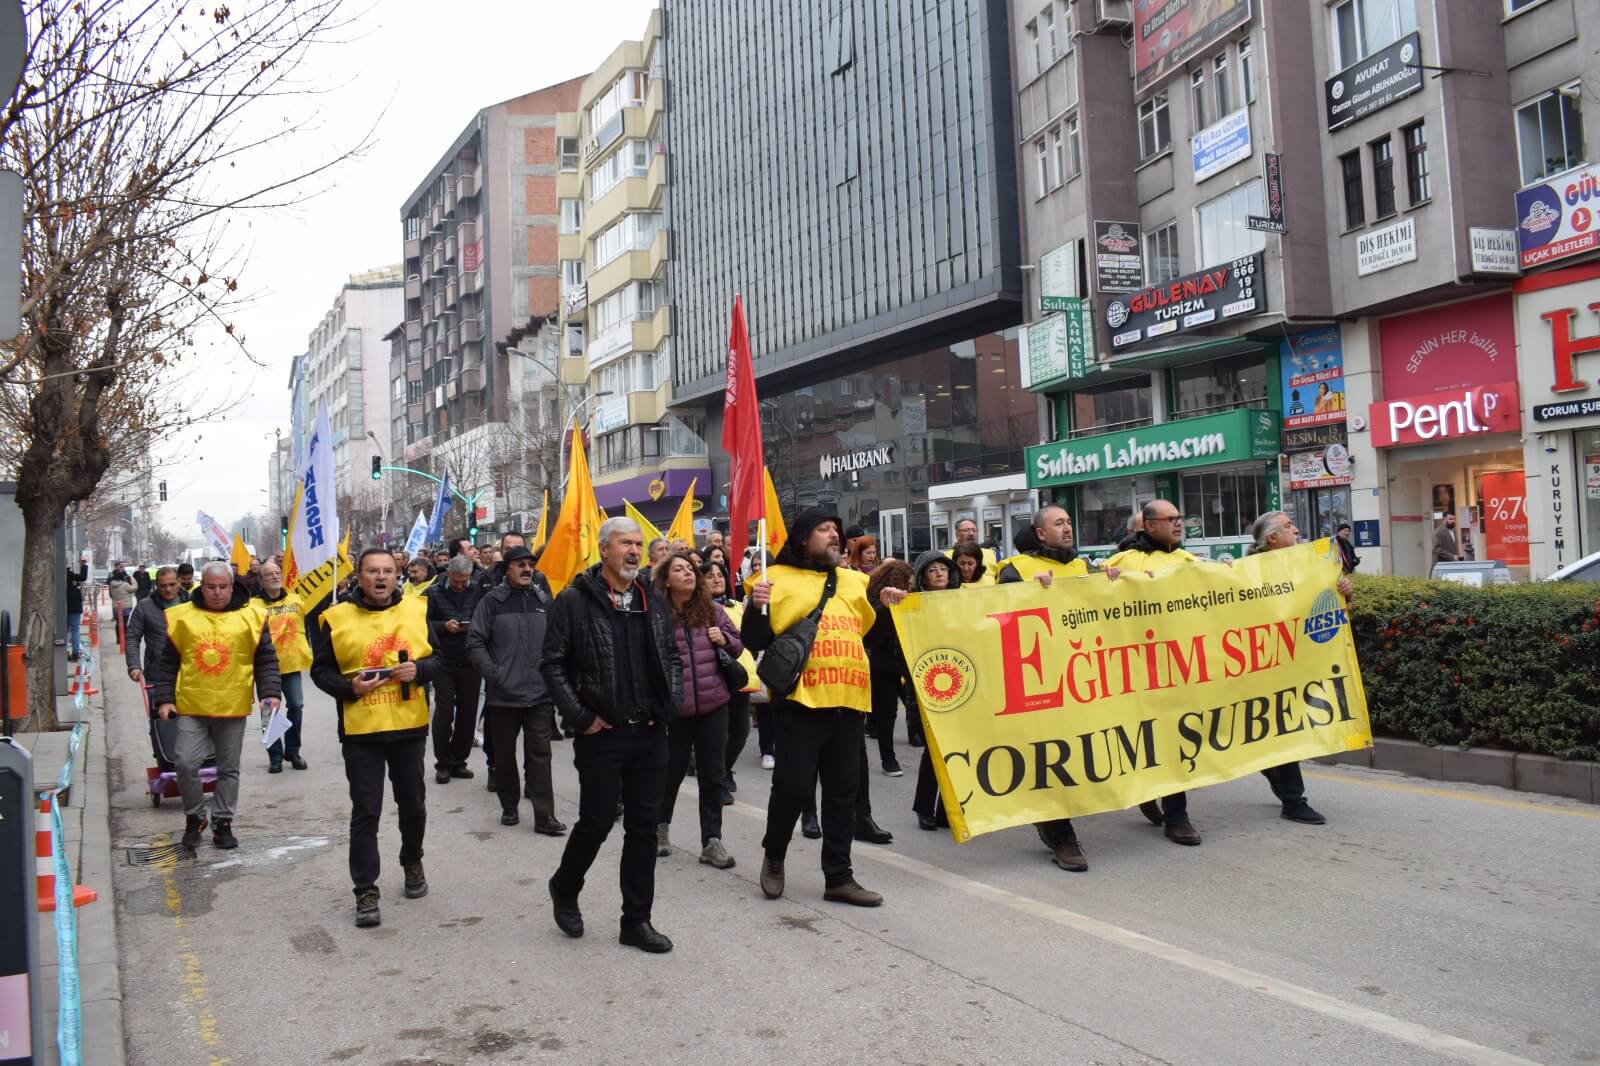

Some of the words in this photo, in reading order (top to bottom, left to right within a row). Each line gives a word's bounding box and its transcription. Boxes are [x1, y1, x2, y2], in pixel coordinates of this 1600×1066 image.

[1354, 57, 1389, 86] AVUKAT
[1332, 99, 1351, 115] Gamze
[1360, 236, 1375, 255] DİŞ
[1376, 221, 1412, 250] HEKİMİ
[1524, 248, 1550, 264] UÇAK
[1551, 234, 1593, 255] BİLETLERİ
[1232, 255, 1254, 269] 0364
[1233, 263, 1255, 279] 666
[1130, 267, 1230, 313] GÜLENAY
[1238, 277, 1252, 289] 19
[1238, 288, 1253, 300] 49
[1042, 298, 1081, 311] Sultan
[1154, 298, 1205, 321] TURİZM
[1069, 311, 1083, 378] LAHMACUN
[1406, 336, 1440, 374] SENİN
[1440, 329, 1467, 346] HER
[1541, 403, 1580, 420] ÇORUM
[832, 446, 891, 474] HALKBANK
[1035, 448, 1101, 480] Sultan
[1103, 432, 1226, 471] Lahmacun
[1061, 608, 1098, 629] eğitim
[1103, 606, 1120, 621] ve
[1123, 600, 1162, 618] bilim
[1166, 587, 1234, 613] emekçileri
[1239, 580, 1295, 602] sendikası
[818, 614, 862, 635] ŞASIN
[1303, 609, 1349, 635] KESK
[986, 607, 1212, 716] EĞİTİM
[1221, 616, 1301, 680] SEN
[1177, 664, 1358, 773] ŞUBESİ
